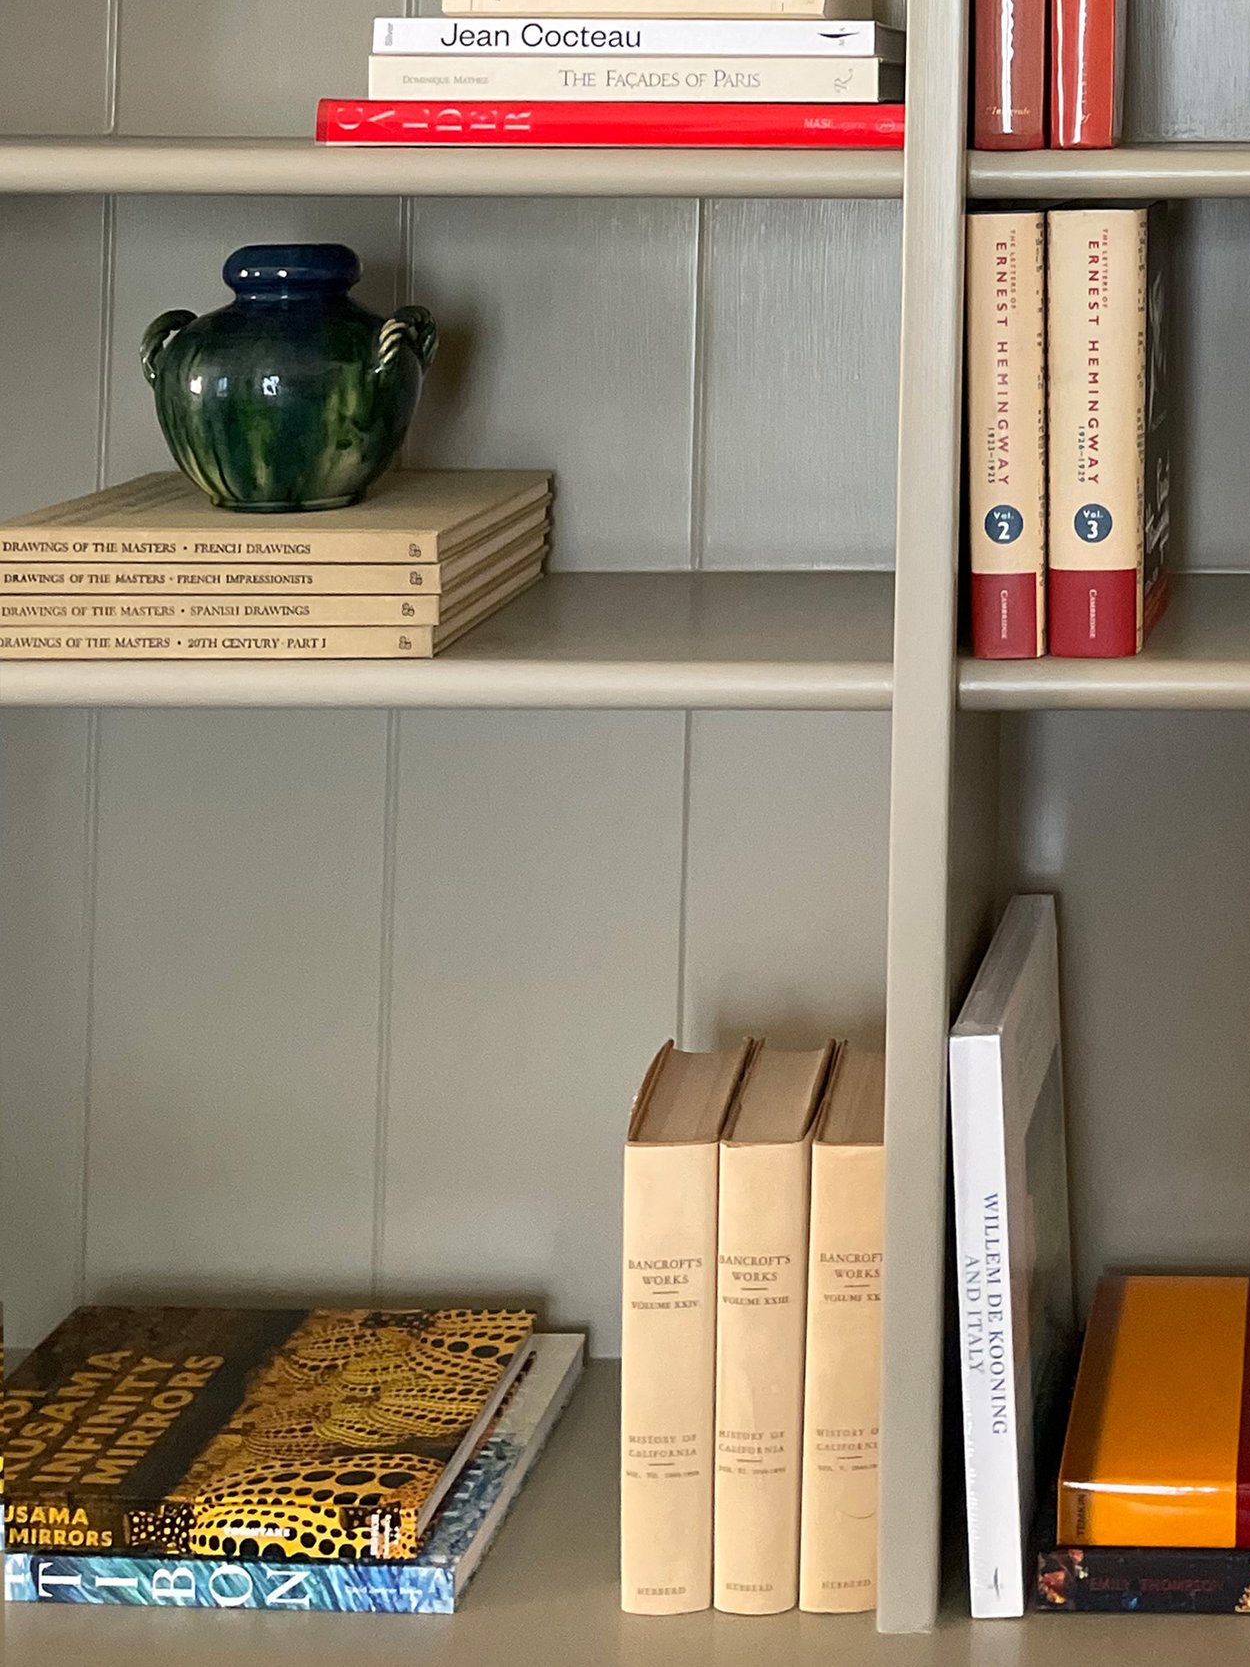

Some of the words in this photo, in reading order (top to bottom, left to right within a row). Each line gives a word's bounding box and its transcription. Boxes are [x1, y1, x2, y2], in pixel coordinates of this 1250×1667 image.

[440, 22, 510, 48] Jean
[520, 22, 642, 50] Cocteau
[558, 68, 597, 88] THE
[605, 68, 681, 91] FAÇADES
[684, 70, 709, 88] OF
[712, 68, 761, 89] PARIS
[995, 241, 1008, 327] ERNEST
[1088, 240, 1100, 326] ERNEST
[996, 341, 1010, 485] HEMINGWAY
[1087, 340, 1100, 484] HEMINGWAY
[993, 511, 1015, 520] Vol.
[1082, 509, 1105, 519] Vol.
[997, 521, 1011, 540] 2
[1085, 519, 1099, 540] 3
[2, 540, 69, 554] DRAWINGS
[73, 541, 89, 553] OF
[92, 541, 118, 553] THE
[121, 542, 177, 554] MASTERS
[193, 543, 242, 554] FRENCH
[246, 543, 311, 555] DRAWINGS
[3, 572, 65, 584] DRAWINGS
[69, 573, 85, 584] OF
[88, 573, 111, 584] THE
[115, 573, 166, 585] MASTERS
[176, 574, 222, 585] FRENCH
[226, 573, 314, 585] IMPRESSIONISTS
[1, 605, 67, 617] DRAWINGS
[71, 605, 88, 617] OF
[91, 605, 117, 617] THE
[121, 605, 176, 617] MASTERS
[190, 605, 241, 617] SPANISH
[244, 605, 310, 617] DRAWINGS
[66, 637, 83, 648] OF
[85, 637, 111, 648] THE
[115, 637, 171, 649] MASTERS
[187, 637, 218, 649] 20TH
[221, 637, 281, 649] CENTURY
[286, 637, 320, 649] PART
[983, 1193, 1003, 1284] WILLEM
[627, 1258, 703, 1270] BANCROFT'S
[718, 1254, 792, 1266] BANCROFT'S
[642, 1274, 690, 1286] WORKS
[731, 1271, 779, 1282] WORKS
[834, 1268, 881, 1280] WORKS
[964, 1255, 982, 1302] AND
[630, 1300, 671, 1310] VOLUME
[986, 1293, 1004, 1323] DE
[966, 1310, 986, 1375] ITALY
[988, 1330, 1008, 1435] KOONING
[31, 1356, 175, 1483] INFINITY
[80, 1354, 225, 1485] MIRRORS
[628, 1448, 698, 1459] CALIFORNIA
[718, 1443, 785, 1455] CALIFORNIA
[9, 1527, 113, 1547] MIRRORS
